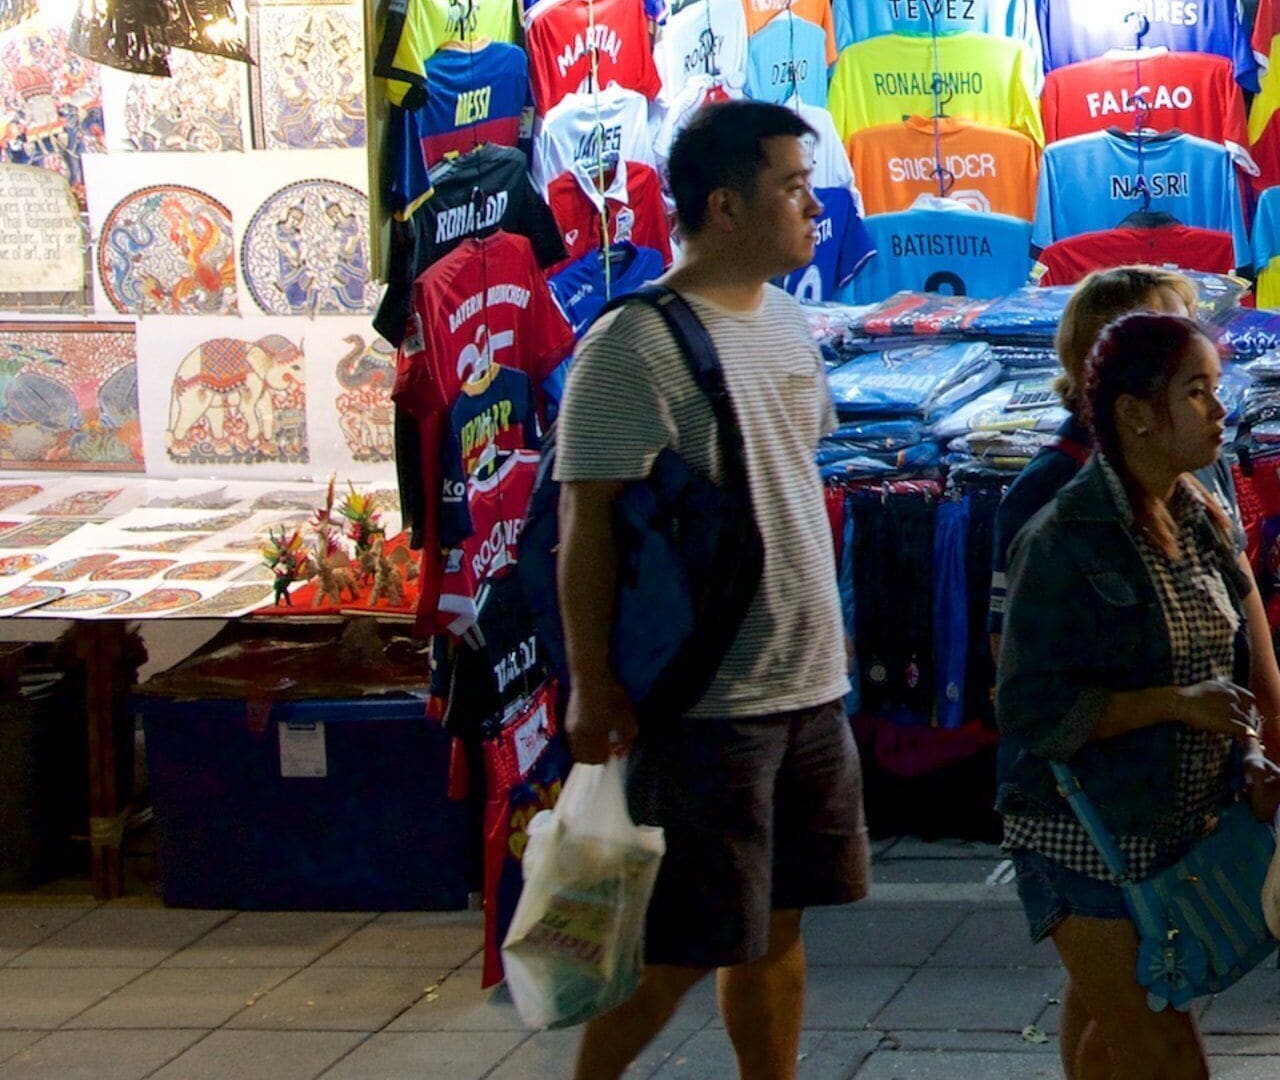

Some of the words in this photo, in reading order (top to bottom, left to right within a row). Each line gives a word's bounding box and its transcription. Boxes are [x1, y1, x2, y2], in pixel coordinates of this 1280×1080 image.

[684, 34, 725, 72] ROOEY
[874, 71, 983, 96] RONALDINHO
[455, 85, 492, 127] MESSI
[1110, 172, 1189, 199] NASRI
[814, 217, 833, 245] STA
[891, 233, 993, 258] BATISTUTA
[449, 291, 484, 333] BAYERN
[471, 518, 526, 577] ROONE
